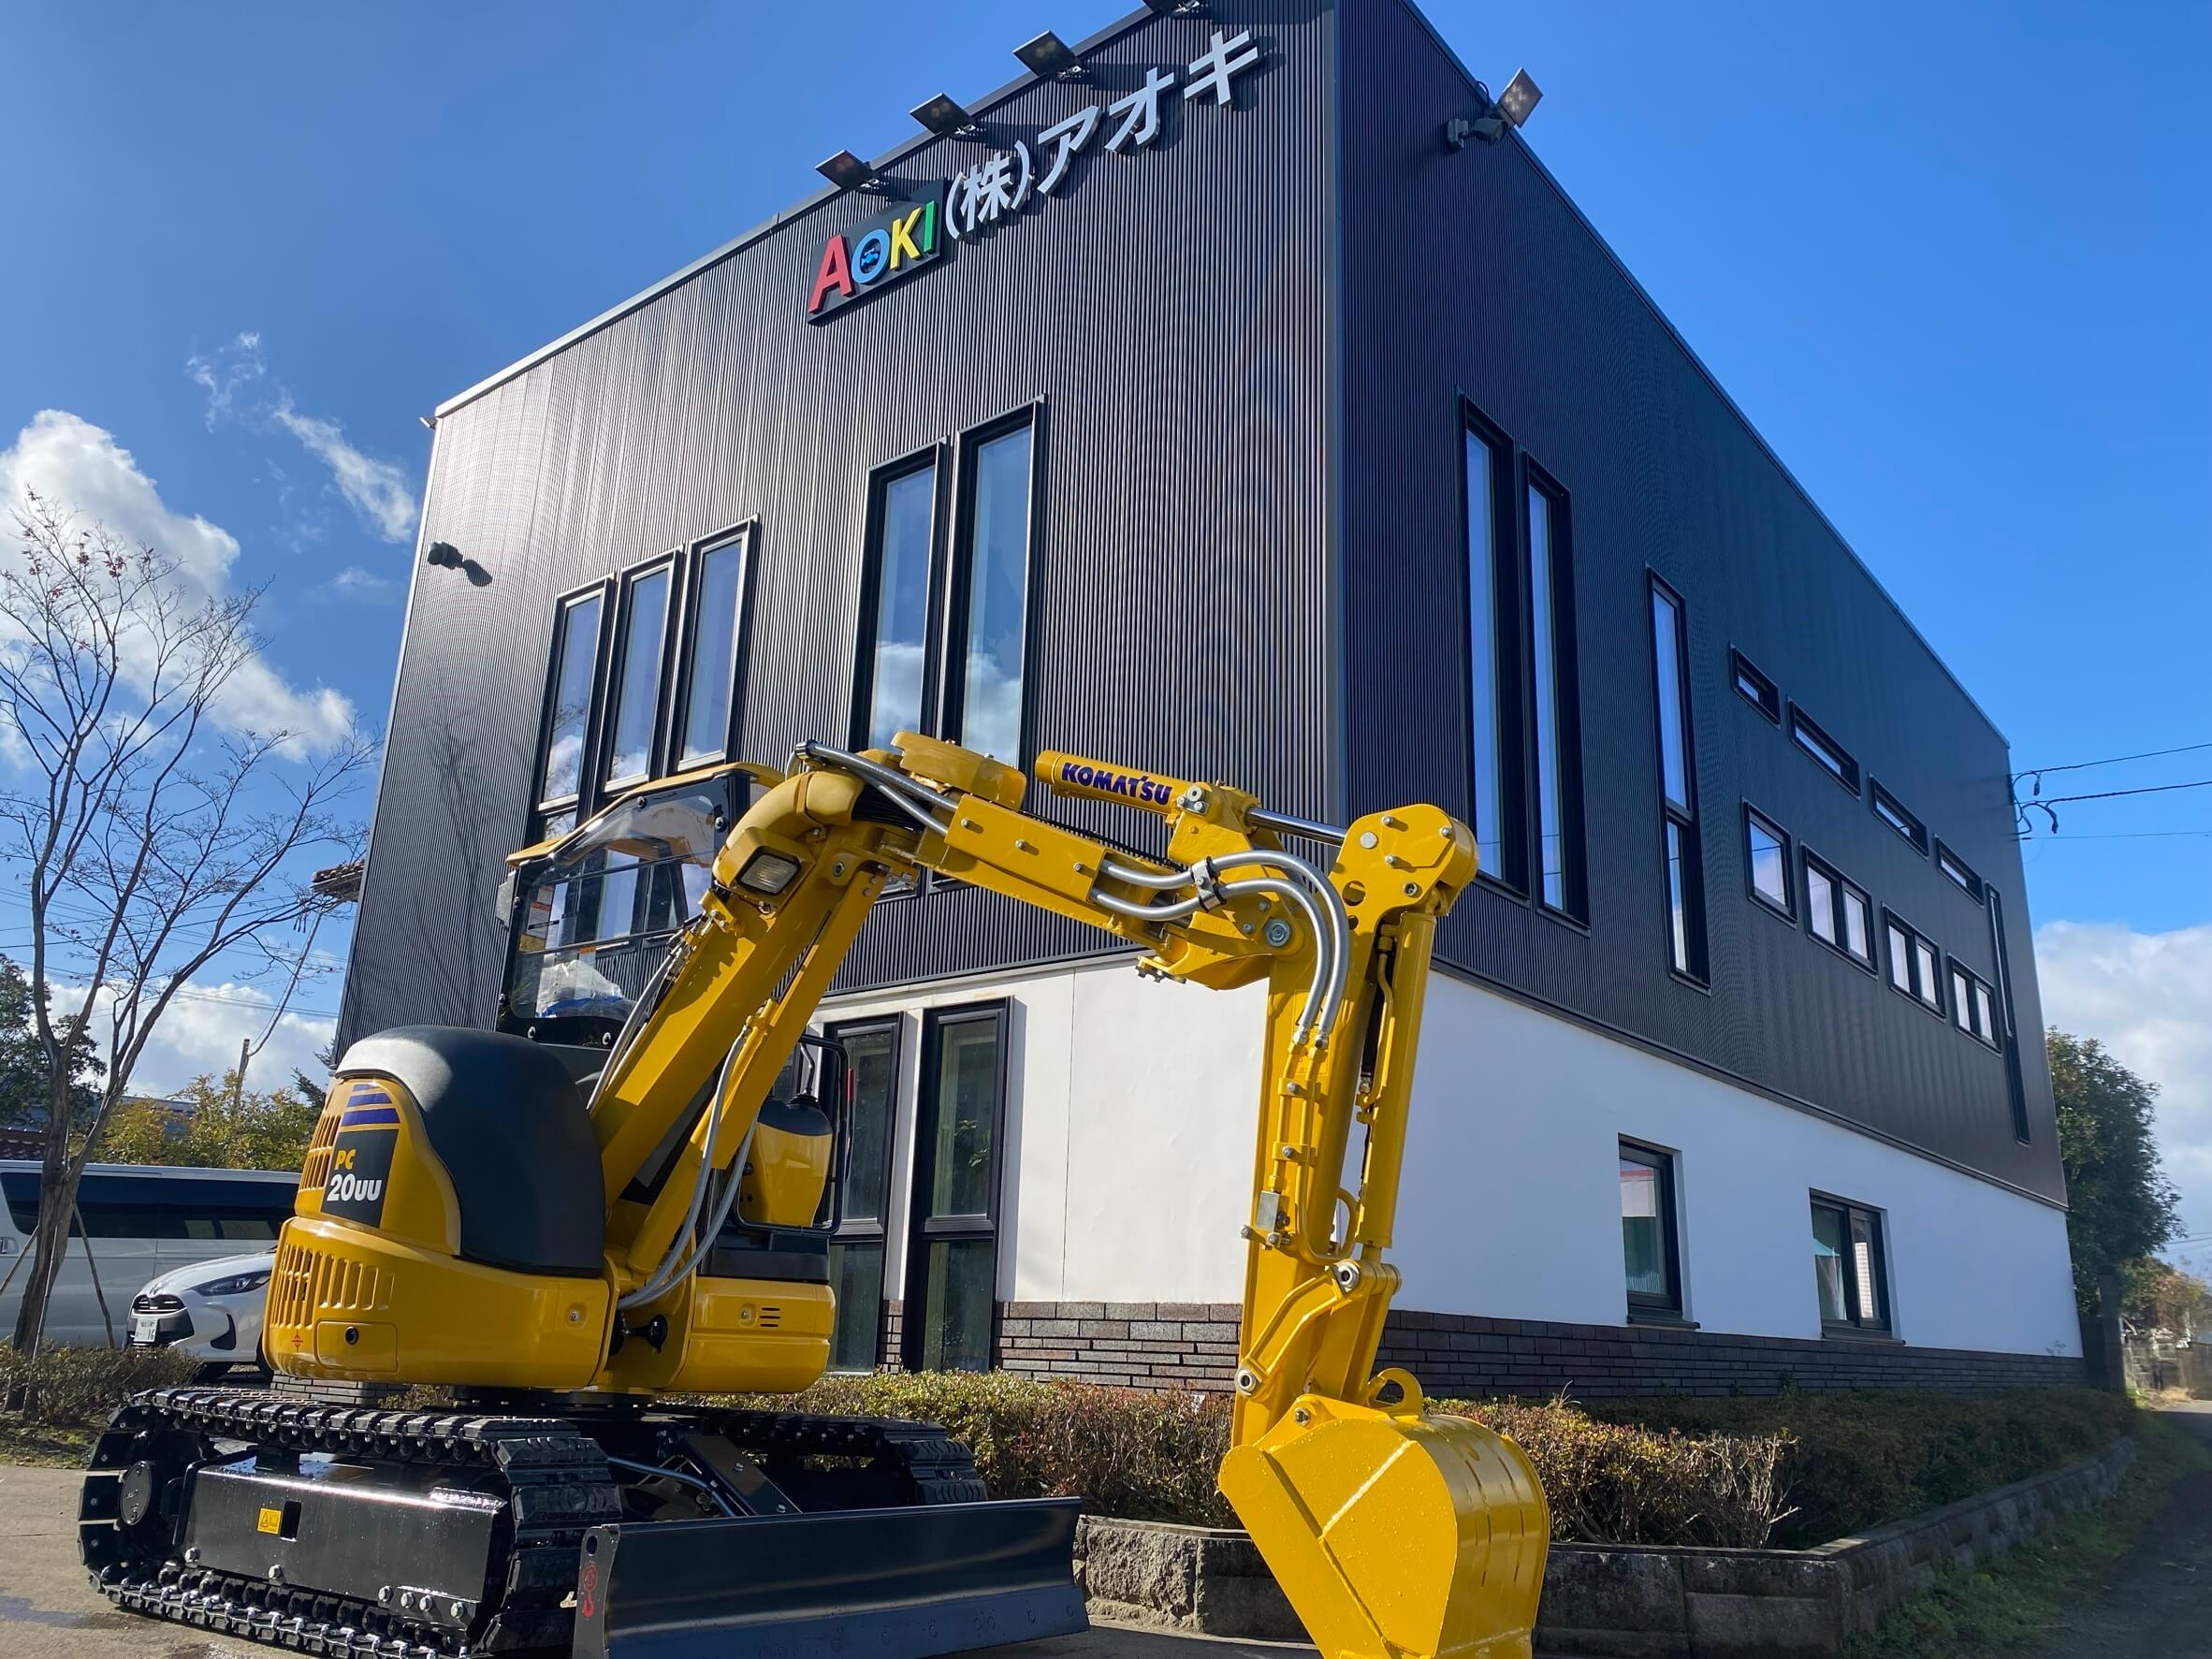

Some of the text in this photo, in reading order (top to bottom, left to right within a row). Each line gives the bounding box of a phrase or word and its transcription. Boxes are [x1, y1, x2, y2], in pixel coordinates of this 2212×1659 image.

[946, 30, 1258, 240] (株)アオキ
[808, 200, 936, 313] AOKI
[1062, 763, 1172, 805] KOMATSU
[335, 1149, 356, 1170] PC
